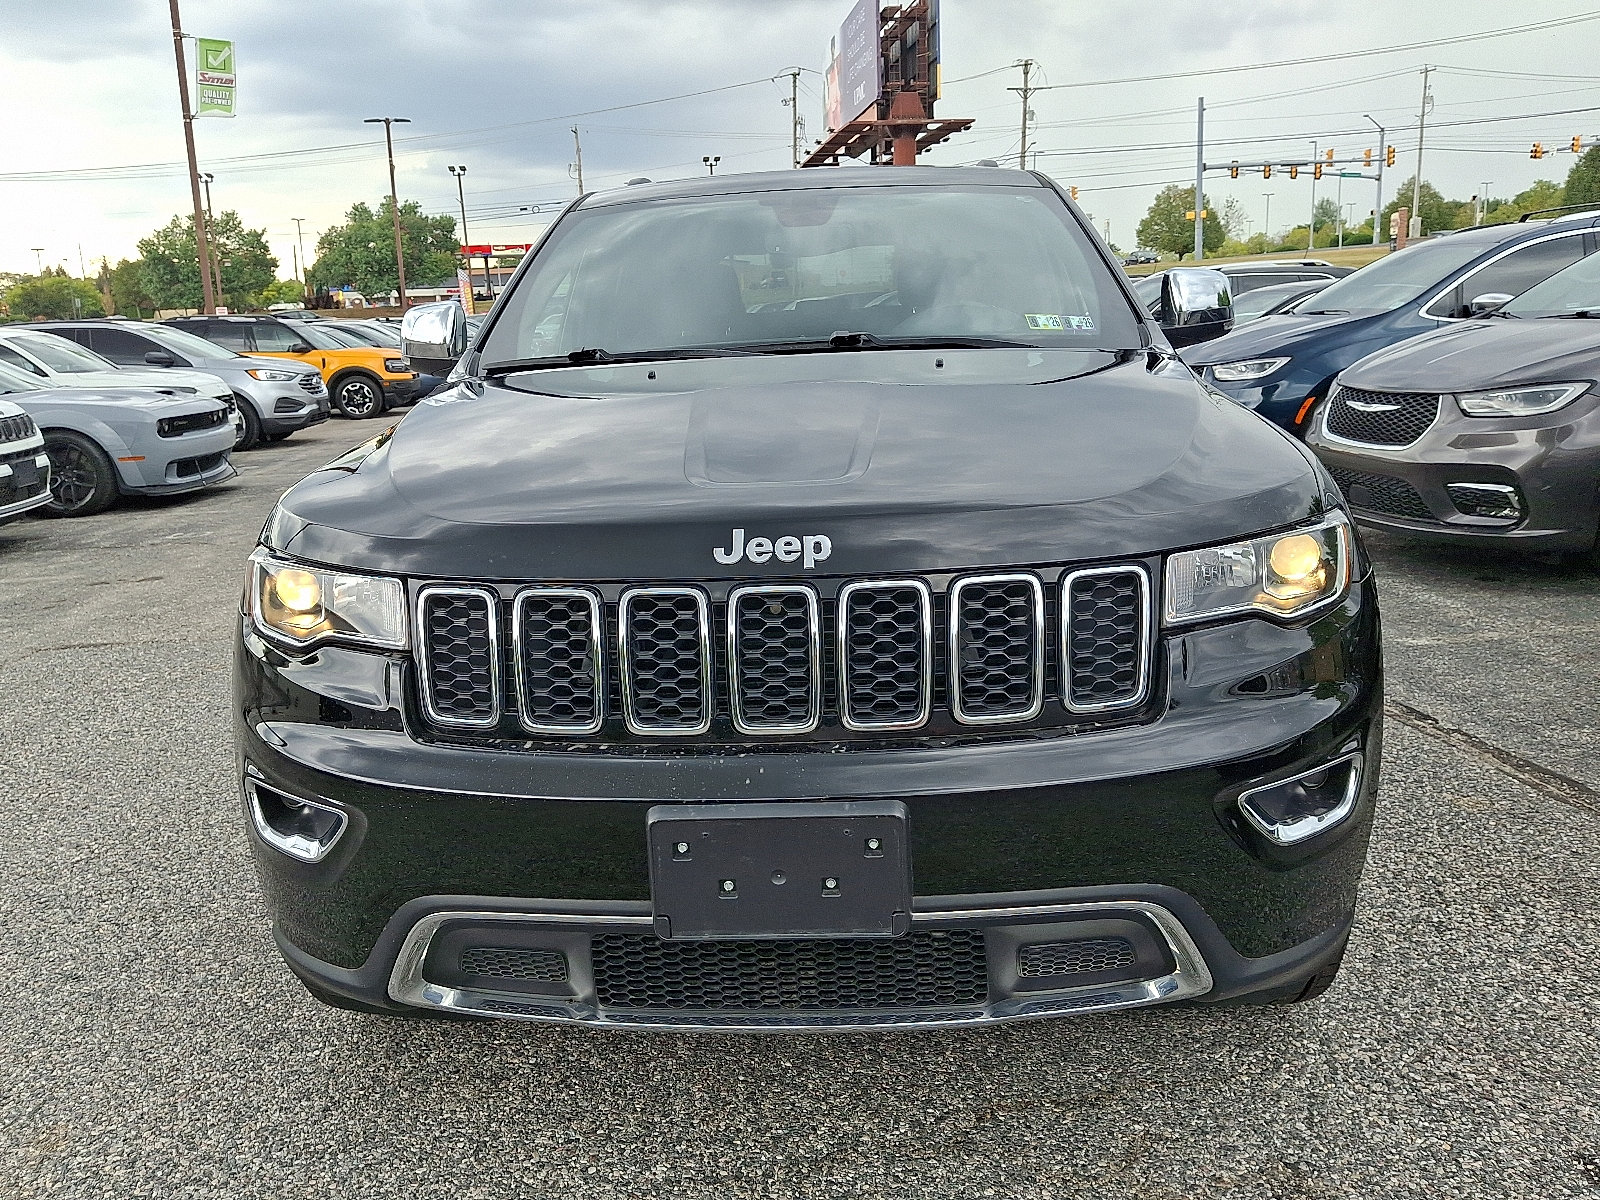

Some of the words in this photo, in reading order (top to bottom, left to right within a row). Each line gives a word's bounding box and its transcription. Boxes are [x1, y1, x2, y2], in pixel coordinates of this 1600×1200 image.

[204, 90, 229, 98] QUALITY
[202, 97, 231, 105] PRE-OWNED
[712, 527, 833, 570] Jeep
